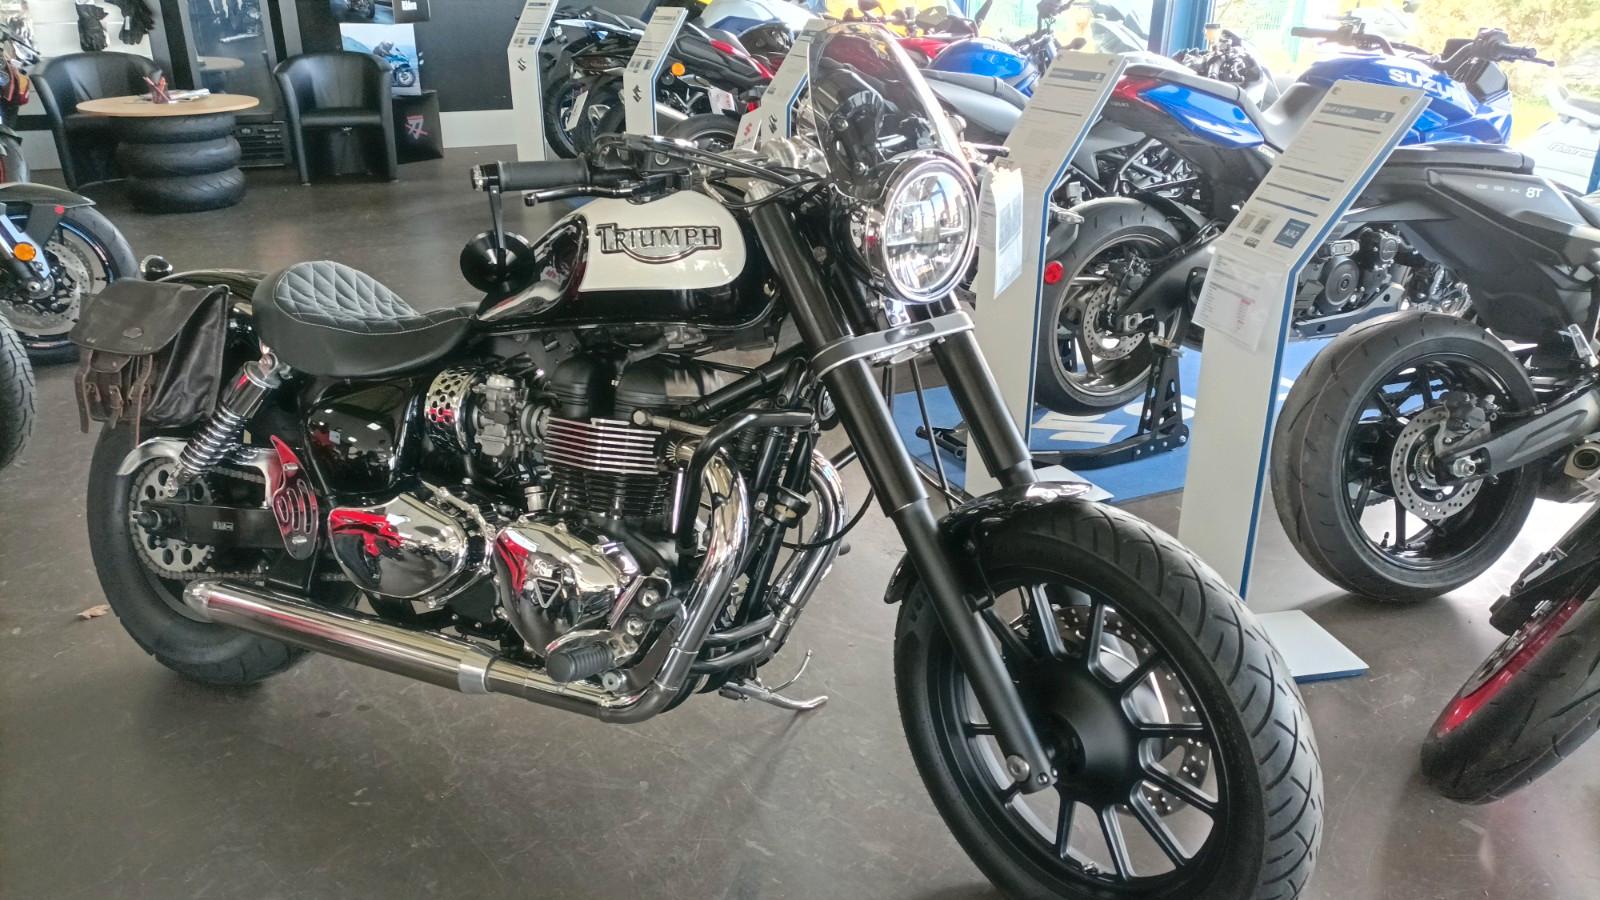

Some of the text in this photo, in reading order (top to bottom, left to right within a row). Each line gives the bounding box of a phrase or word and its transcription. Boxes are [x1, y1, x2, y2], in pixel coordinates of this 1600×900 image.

[1388, 68, 1468, 106] SUZU
[1525, 186, 1544, 199] 8T
[597, 224, 719, 250] TRIUMPH
